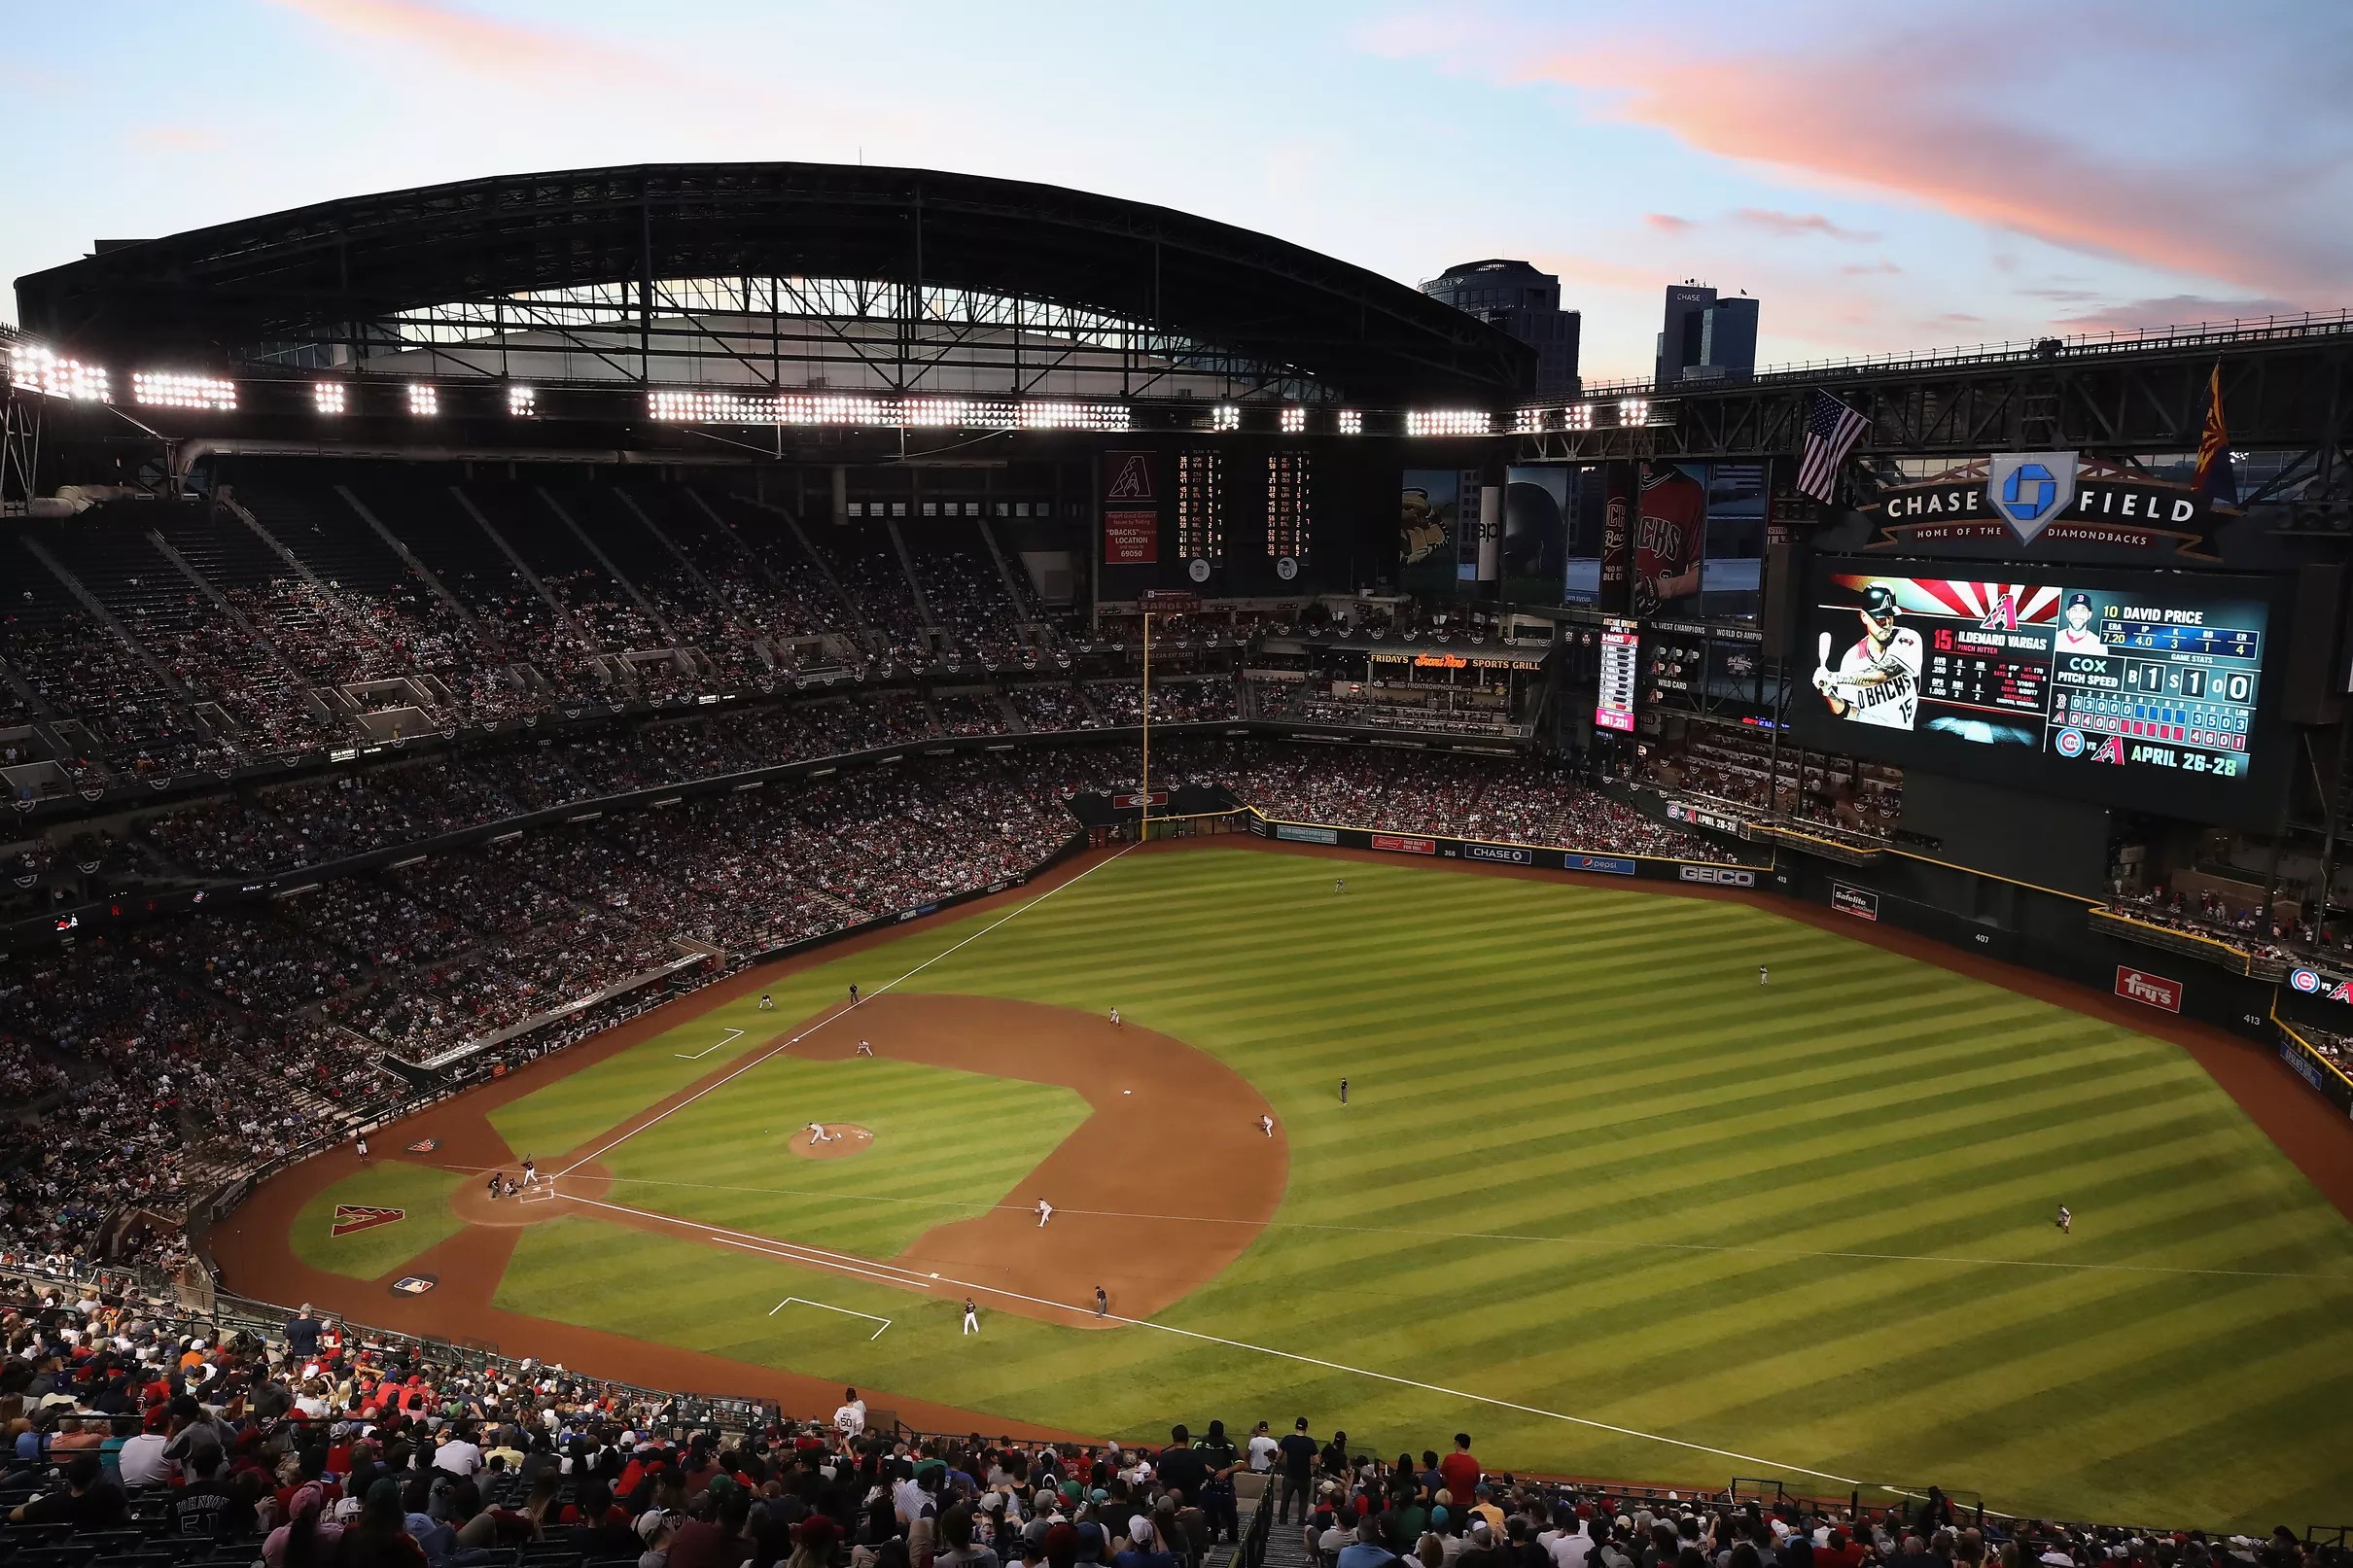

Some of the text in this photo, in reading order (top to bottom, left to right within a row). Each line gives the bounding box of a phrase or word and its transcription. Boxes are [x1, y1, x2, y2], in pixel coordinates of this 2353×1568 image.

[1888, 491, 2195, 523] CHASE FIELD
[1917, 529, 1949, 539] HOME
[1981, 527, 2002, 536] THE
[2049, 529, 2148, 546] DIAMONDBACKS
[1603, 618, 1621, 627] ARCHIE
[2103, 606, 2204, 625] 10 DAVID PRICE
[1674, 624, 1705, 635] CHAMPIONS
[1717, 629, 1736, 639] WORLD
[1934, 630, 1952, 650] 15
[2008, 636, 2048, 651] VARGAS
[2103, 633, 2244, 656] 7.20 4.0 3 1 4
[1472, 659, 1509, 669] SPORTS
[1513, 661, 1540, 671] GRILL
[2070, 657, 2108, 674] COX
[2193, 655, 2214, 664] STATS
[1658, 679, 1687, 690] WILD CARD
[2058, 672, 2119, 688] PITCH SPEED
[2128, 670, 2138, 683] B
[2148, 667, 2159, 689] 1
[2169, 675, 2179, 688] S
[2190, 672, 2200, 694] 1
[2230, 677, 2248, 699] 0
[1868, 675, 1914, 708] BACKS
[1929, 687, 1947, 696] 1.000
[1899, 698, 1914, 723] 15
[2073, 698, 2244, 730] 0 3 0 0 0 3 5 0 3
[2071, 714, 2241, 748] 0 4 0 0 4 6 0 1
[2131, 745, 2237, 777] APRIL 26-28
[1698, 812, 1738, 832] APRIL 26-28
[1474, 848, 1510, 859] CHASE
[1595, 859, 1617, 871] pepsi
[1682, 868, 1753, 885] GEICO
[1836, 891, 1867, 906] Safelite
[1976, 934, 1989, 944] 407
[2125, 974, 2171, 1005] fry's
[2244, 1015, 2261, 1026] 413
[841, 1418, 853, 1428] 50
[176, 1495, 229, 1514] JOHNSON
[182, 1513, 218, 1535] 51
